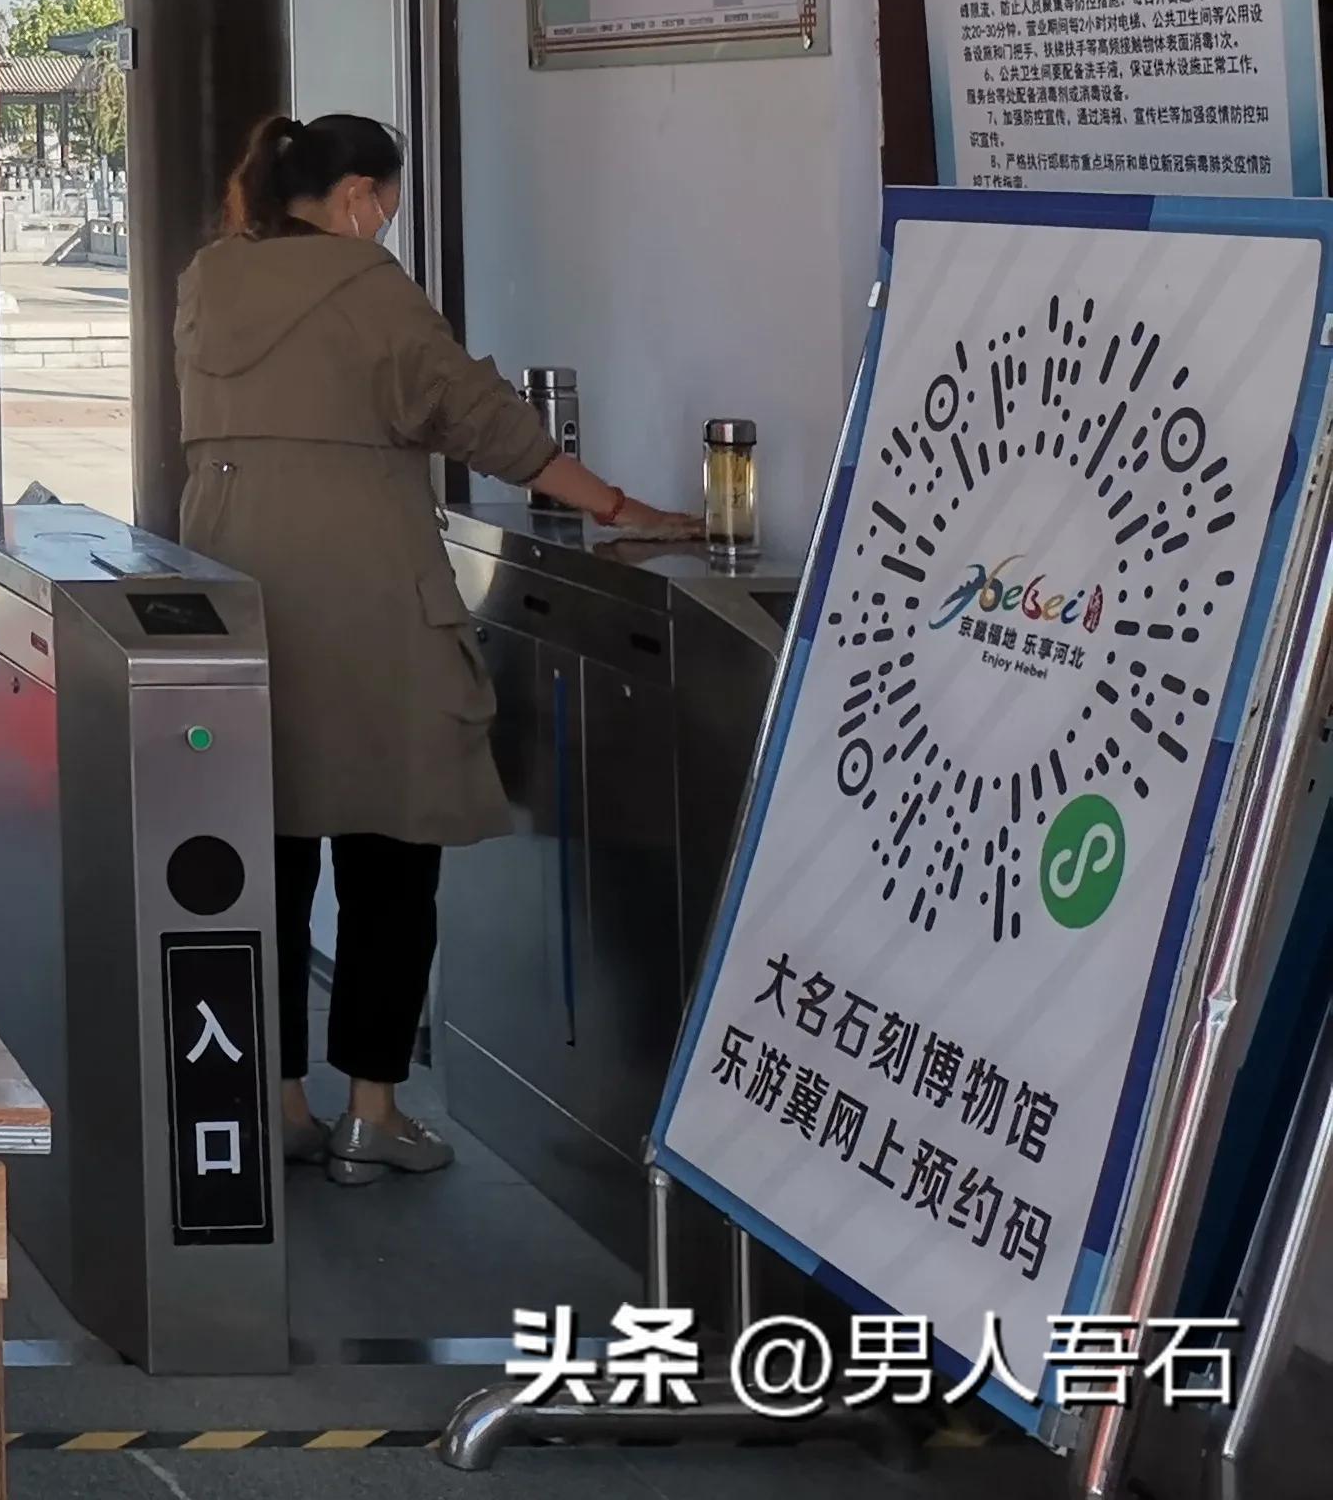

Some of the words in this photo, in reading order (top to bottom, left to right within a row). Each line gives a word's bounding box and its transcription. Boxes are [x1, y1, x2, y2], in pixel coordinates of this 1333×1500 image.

[969, 131, 1006, 149] 识宣传。
[981, 650, 1012, 672] Enjoy
[1014, 661, 1049, 680] Hebei
[1022, 633, 1086, 670] 乐享河北
[186, 1000, 243, 1176] 入口
[754, 953, 1060, 1163] 大名石刻博物馆
[711, 1025, 1053, 1281] 乐游冀网上预约码
